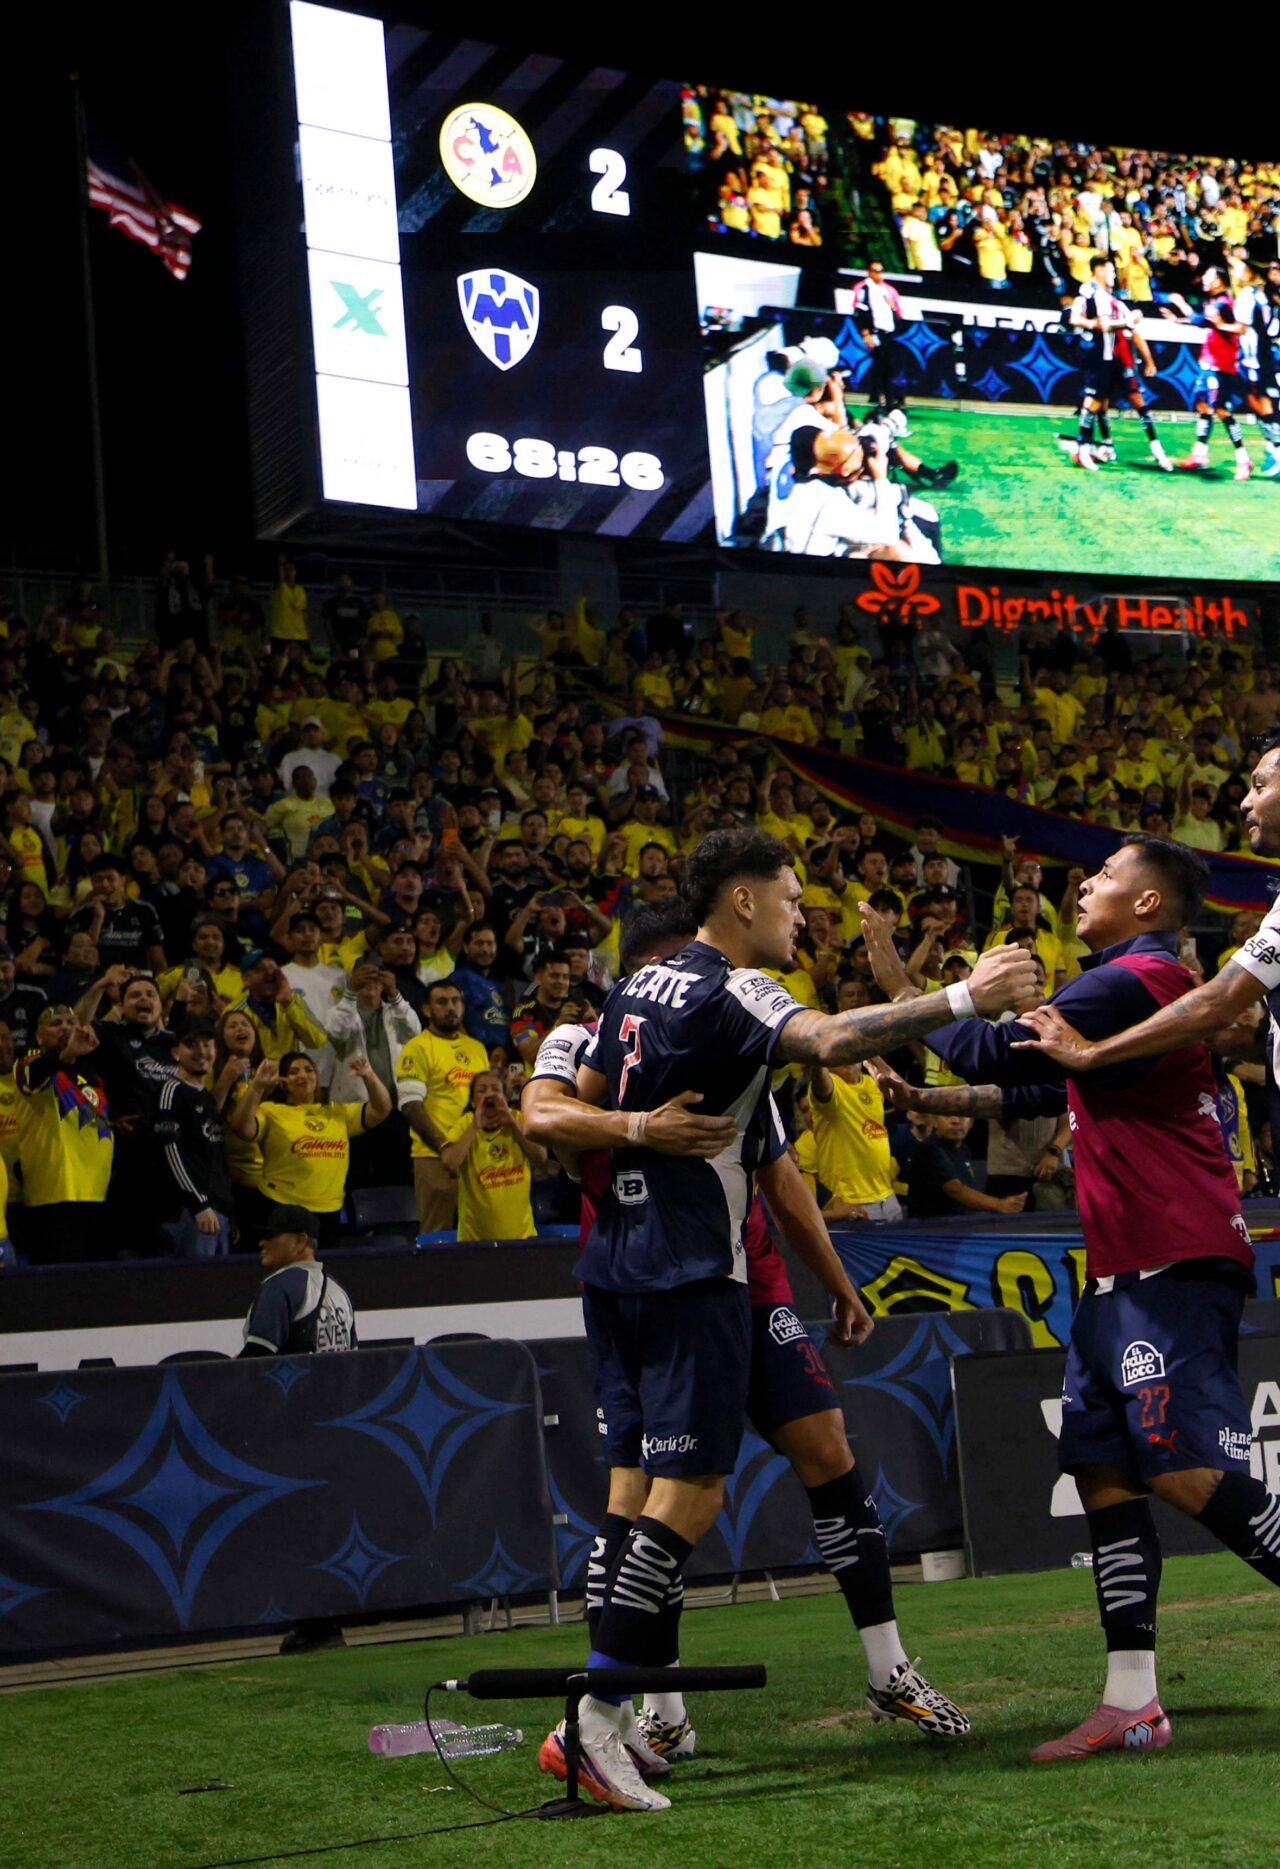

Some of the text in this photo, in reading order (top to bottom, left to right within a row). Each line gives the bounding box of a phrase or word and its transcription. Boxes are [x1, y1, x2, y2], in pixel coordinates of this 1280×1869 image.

[590, 148, 631, 217] 2
[602, 305, 644, 373] 2
[467, 432, 666, 491] 68:26
[956, 587, 1248, 642] Dignity Health
[619, 1013, 648, 1107] 7
[1126, 1352, 1155, 1370] POLLO
[1127, 1364, 1156, 1381] LOCO
[1137, 1384, 1170, 1428] 27
[649, 1434, 699, 1455] Carl's Jr.
